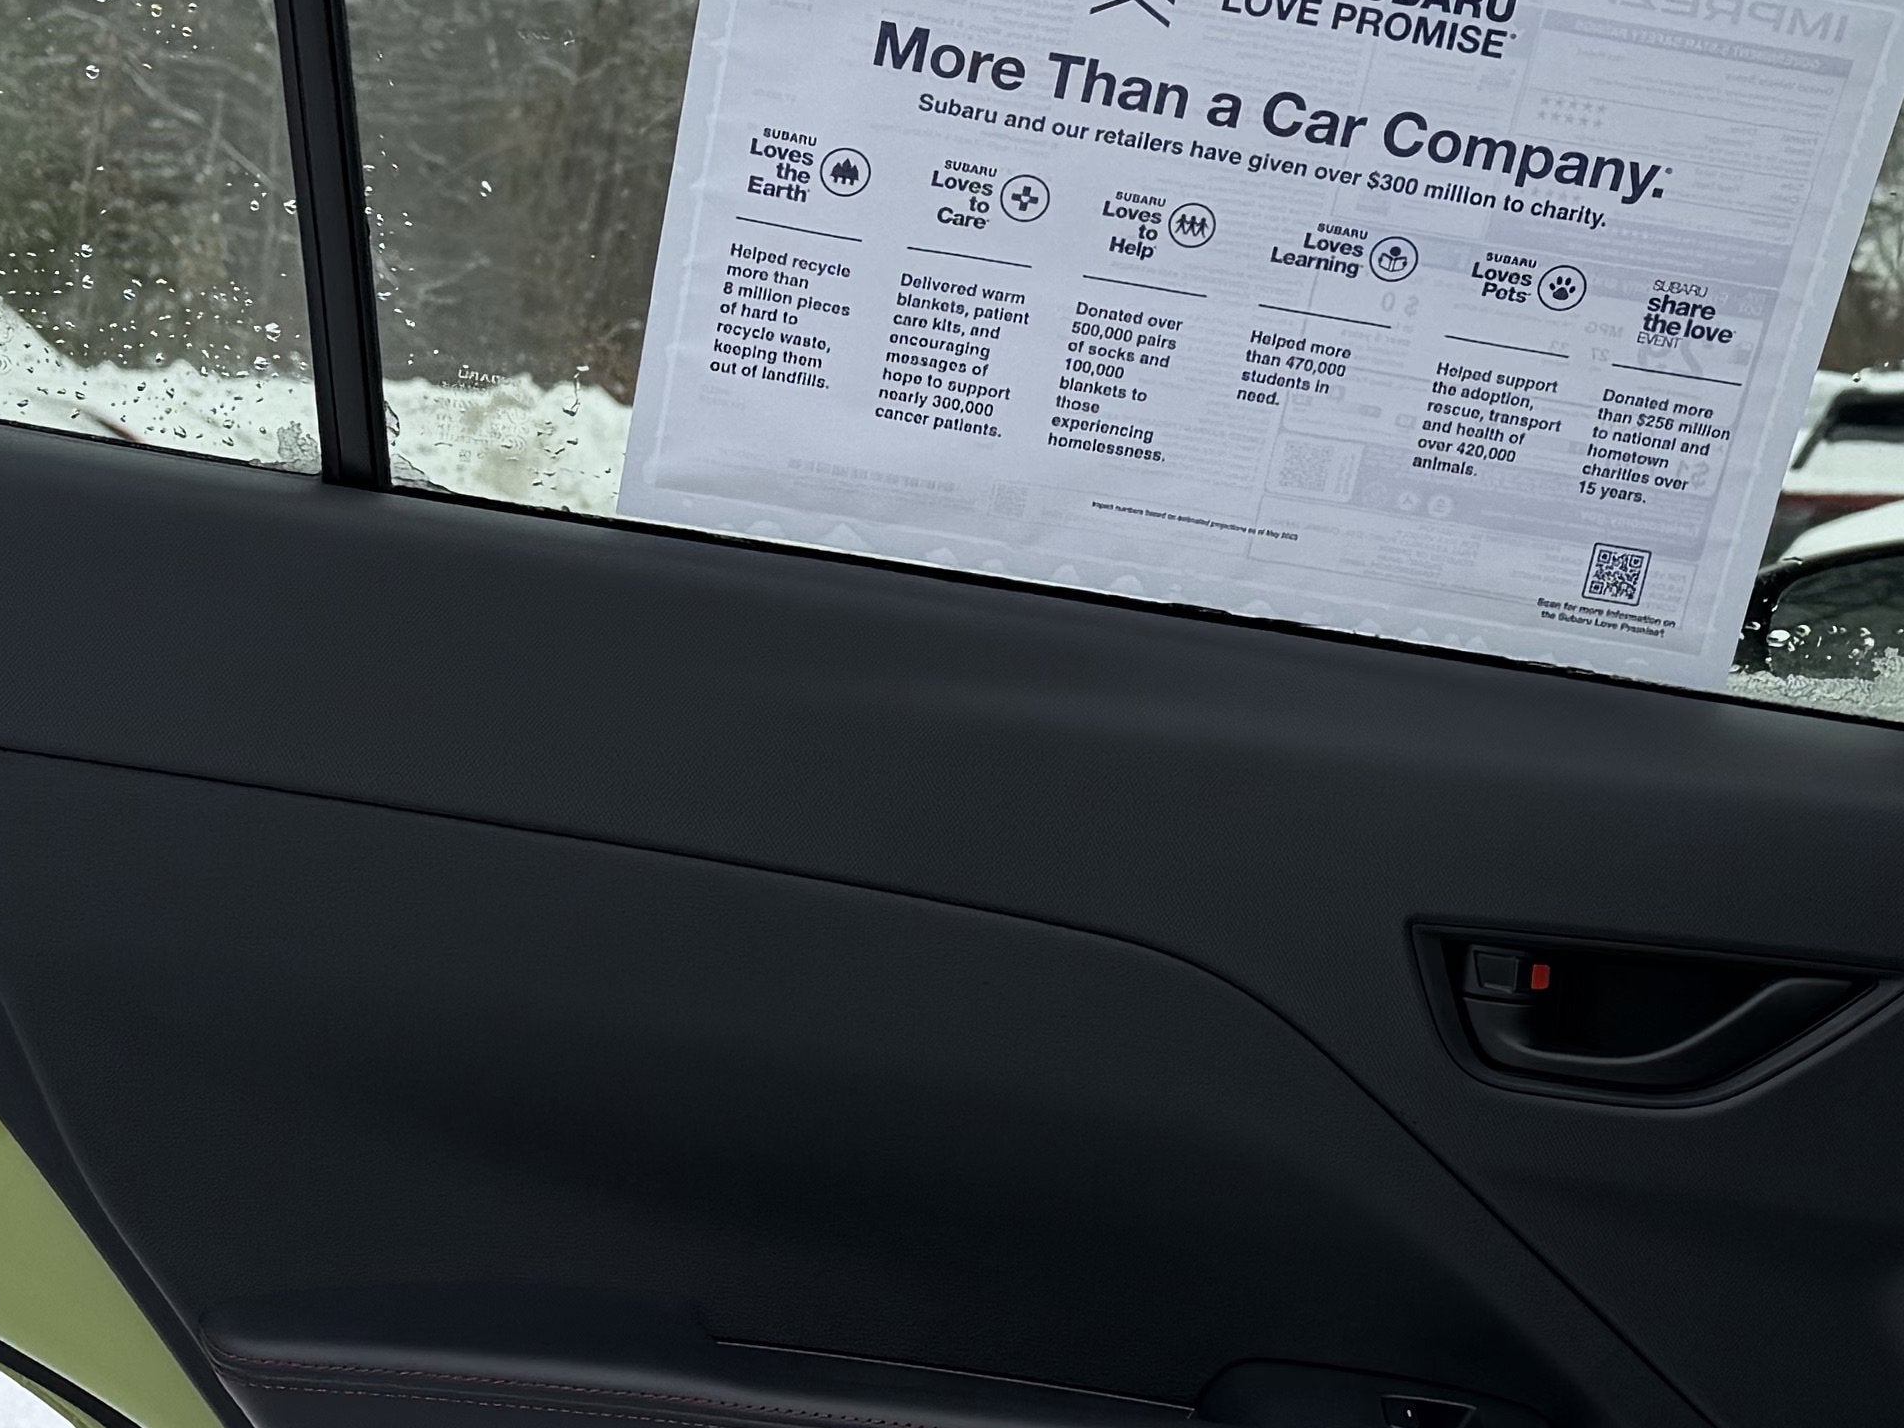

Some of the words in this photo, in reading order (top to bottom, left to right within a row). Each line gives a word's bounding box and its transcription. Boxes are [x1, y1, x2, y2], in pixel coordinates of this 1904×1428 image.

[872, 20, 1026, 92] More
[1047, 51, 1189, 120] Than
[1206, 92, 1242, 129] a
[1262, 91, 1369, 149] Car
[762, 127, 818, 147] SUBARU
[749, 138, 814, 167] Loves
[918, 93, 998, 125] Subaru
[1003, 113, 1047, 133] and
[1051, 121, 1090, 140] our
[1094, 128, 1184, 156] retailers
[1189, 139, 1242, 166] have
[1247, 152, 1308, 178] given
[1314, 166, 1363, 186] over
[1366, 170, 1419, 196] $300
[1423, 182, 1497, 209] million
[1502, 194, 1525, 213] to
[1530, 199, 1606, 231] charity.
[775, 162, 811, 185] the
[944, 159, 998, 178] SUBARU
[747, 175, 810, 203] Earth
[930, 169, 994, 197] Loves
[968, 195, 990, 214] to
[1101, 200, 1163, 225] Loves
[1115, 190, 1167, 208] SUBARU
[936, 206, 990, 230] Care
[1316, 222, 1369, 241] SUBARU
[1138, 223, 1159, 242] to
[1302, 232, 1365, 258] Loves
[730, 242, 789, 267] Helped
[791, 257, 851, 278] recycle
[1108, 235, 1157, 261] Help
[1270, 245, 1362, 279] Learning
[1485, 251, 1538, 269] SUBARU
[726, 264, 769, 282] more
[772, 270, 809, 290] than
[1471, 261, 1533, 287] Loves
[1653, 279, 1708, 297] SUBARU
[722, 281, 734, 295] 8
[737, 284, 793, 305] million
[795, 295, 851, 317] pieces
[900, 272, 978, 297] Delivered
[981, 287, 1026, 305] warm
[1481, 281, 1530, 304] Pets
[719, 301, 738, 316] of
[740, 302, 779, 323] hard
[782, 310, 799, 326] to
[896, 291, 970, 319] blankets,
[972, 306, 1030, 326] patient
[1075, 301, 1144, 325] Donated
[1146, 316, 1184, 332] over
[1647, 293, 1716, 321] share
[716, 321, 776, 342] recycle
[779, 332, 831, 354] waste,
[892, 313, 929, 329] care
[931, 316, 966, 338] kits,
[969, 325, 1001, 340] and
[1071, 320, 1134, 343] 500,000
[1135, 333, 1177, 351] pairs
[1636, 332, 1682, 349] EVENT
[1642, 312, 1682, 337] the
[1682, 318, 1733, 344] love
[713, 337, 778, 365] keeping
[782, 349, 823, 369] them
[889, 333, 991, 362] encouraging
[1067, 340, 1085, 354] of
[1087, 344, 1135, 363] socks
[1138, 353, 1171, 369] and
[1249, 329, 1307, 352] Helped
[1309, 343, 1352, 360] more
[709, 360, 738, 376] out
[740, 364, 759, 379] of
[761, 365, 829, 390] landfills.
[885, 351, 967, 374] messages
[971, 363, 990, 378] of
[1065, 357, 1125, 380] 100,000
[1245, 348, 1282, 368] than
[1284, 355, 1347, 378] 470,000
[882, 366, 923, 387] hope
[927, 373, 943, 389] to
[946, 380, 1011, 401] support
[1058, 375, 1127, 400] blankets
[1131, 387, 1148, 403] to
[1240, 369, 1311, 392] students
[1314, 378, 1330, 395] in
[1436, 361, 1493, 384] Helped
[1495, 373, 1559, 394] support
[878, 388, 929, 409] nearly
[931, 394, 994, 418] 300,000
[1055, 394, 1101, 415] those
[1236, 389, 1280, 406] need.
[1431, 380, 1457, 397] the
[1460, 387, 1534, 412] adoption,
[1602, 388, 1670, 412] Donated
[1672, 403, 1714, 420] more
[874, 407, 930, 426] cancer
[932, 416, 1002, 438] patients.
[1051, 415, 1154, 445] experiencing
[1426, 401, 1485, 424] rescue,
[1488, 408, 1562, 433] transport
[1597, 407, 1633, 430] than
[1630, 412, 1676, 432] $256
[1677, 421, 1731, 441] million
[1421, 419, 1453, 434] and
[1455, 421, 1505, 443] health
[1508, 432, 1527, 446] of
[1591, 425, 1609, 440] to
[1611, 430, 1678, 452] national
[1679, 441, 1711, 457] and
[1047, 431, 1165, 463] homelessness.
[1417, 438, 1454, 453] over
[1456, 441, 1517, 463] 420,000
[1586, 443, 1669, 470] hometown
[1412, 455, 1478, 477] animals.
[1581, 462, 1651, 485] charities
[1654, 475, 1690, 491] over
[1578, 480, 1598, 496] 15
[1598, 485, 1647, 504] years.
